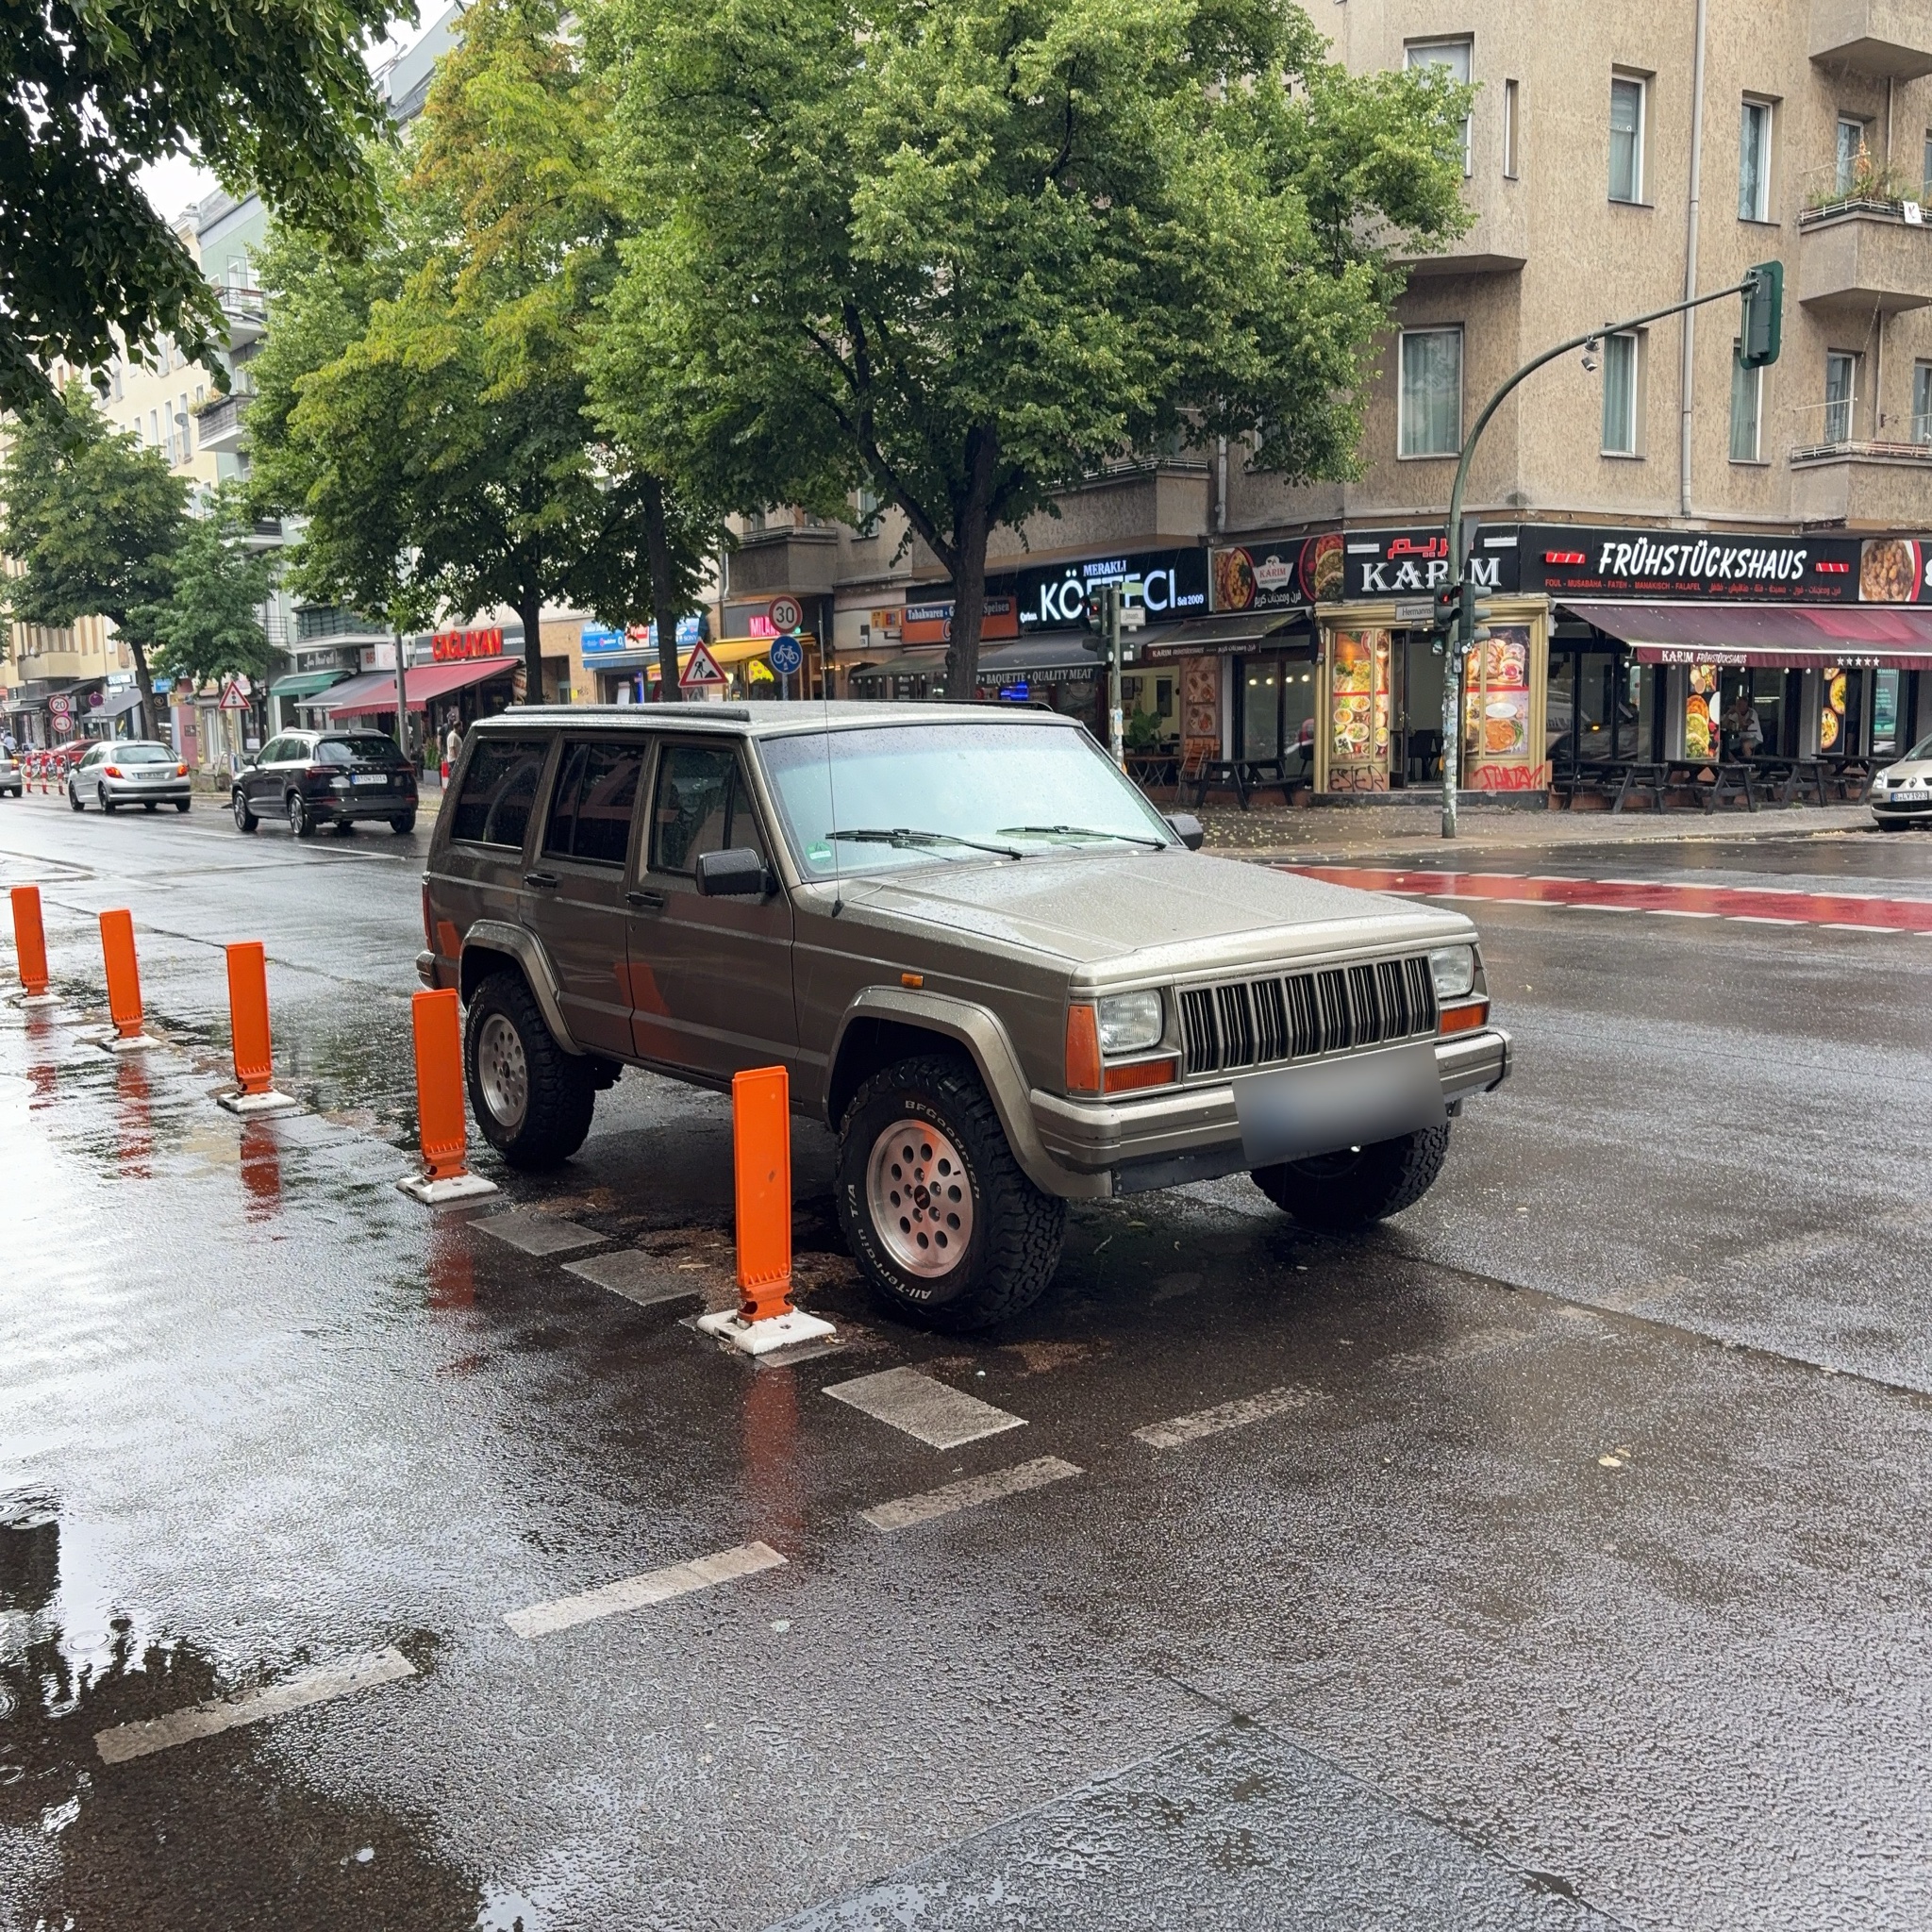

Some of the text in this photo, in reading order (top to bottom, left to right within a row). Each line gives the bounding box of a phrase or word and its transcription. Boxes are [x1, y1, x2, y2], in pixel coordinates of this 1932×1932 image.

[1388, 537, 1474, 559] ريم
[1598, 537, 1807, 579] FRÜHSTÜCKSHAUS
[1083, 560, 1127, 577] MERAKLI
[1259, 567, 1286, 578] KARIM
[1361, 557, 1502, 592] KARM
[1545, 578, 1561, 587] FOUL
[1634, 581, 1670, 591] MANAKISCH
[1675, 582, 1701, 591] FALAFEL
[1187, 593, 1205, 606] 2009
[775, 606, 795, 624] 30
[908, 608, 943, 621] Tabakwaren
[984, 601, 1010, 614] Speisen
[1402, 606, 1434, 617] Hermannst
[1661, 650, 1694, 663] KARIM
[986, 672, 1026, 686] BAQUETTE
[1032, 669, 1068, 684] QUALITY
[1069, 668, 1093, 679] MEAT
[54, 700, 65, 709] 20
[905, 1099, 980, 1200] BFGoodrich
[847, 1184, 933, 1301] All-Terrain T/A
